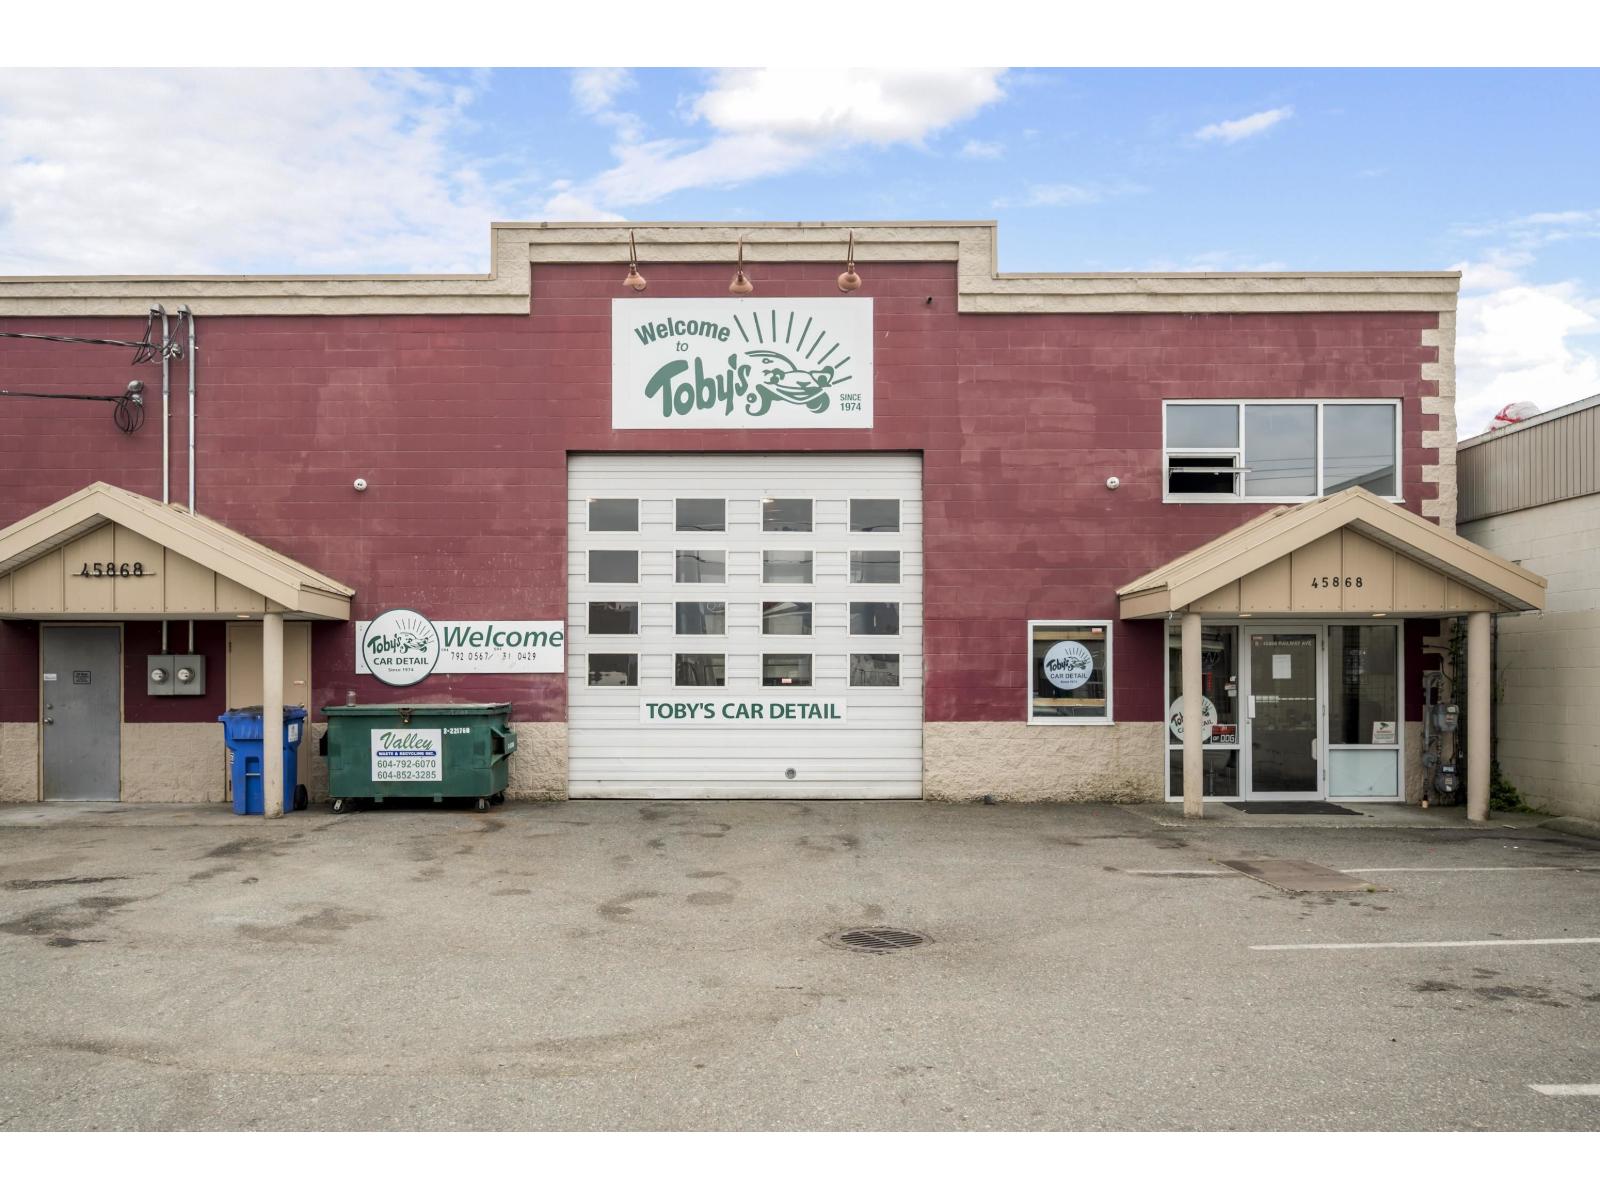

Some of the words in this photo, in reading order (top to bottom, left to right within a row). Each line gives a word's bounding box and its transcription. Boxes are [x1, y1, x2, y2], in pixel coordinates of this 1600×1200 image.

[634, 317, 731, 346] Welcome
[675, 341, 689, 352] to
[644, 353, 751, 418] Toby's
[839, 393, 862, 402] SINCE
[839, 402, 862, 412] 1974
[80, 562, 144, 578] 45868
[1311, 576, 1363, 589] 45868
[443, 625, 564, 648] Welcome
[366, 633, 402, 654] Toby's
[373, 657, 393, 665] CAR
[396, 657, 429, 665] DETAIL
[450, 652, 464, 661] 792
[517, 652, 537, 661] 0429
[645, 702, 716, 719] TOBY'S
[721, 702, 764, 719] CAR
[769, 702, 842, 719] DETAIL
[380, 731, 433, 750] Valley
[377, 760, 436, 768] 604-792-6070
[377, 771, 437, 779] 604-852-3285
